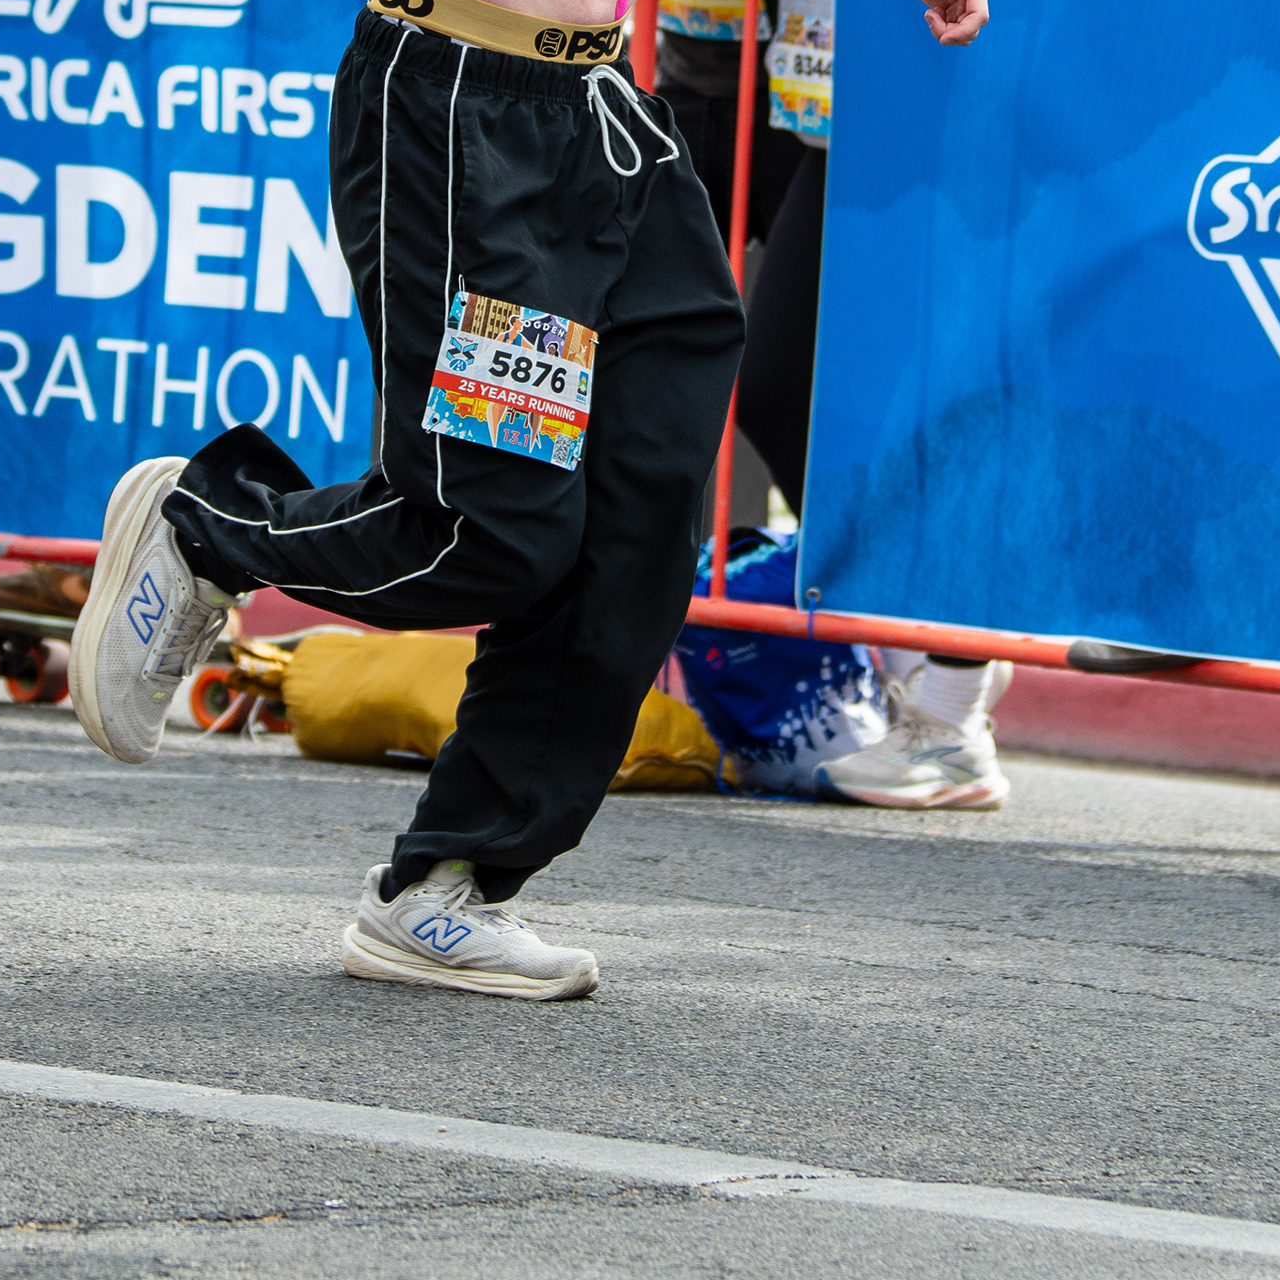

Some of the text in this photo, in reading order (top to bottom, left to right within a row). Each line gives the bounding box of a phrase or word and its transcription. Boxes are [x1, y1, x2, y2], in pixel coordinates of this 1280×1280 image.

[565, 25, 621, 62] PSD
[522, 320, 566, 338] OGDEN
[488, 349, 568, 394] 5876
[458, 379, 475, 393] 25
[480, 384, 526, 406] YEARS
[528, 398, 576, 422] RUNNING
[503, 428, 530, 447] 13.1
